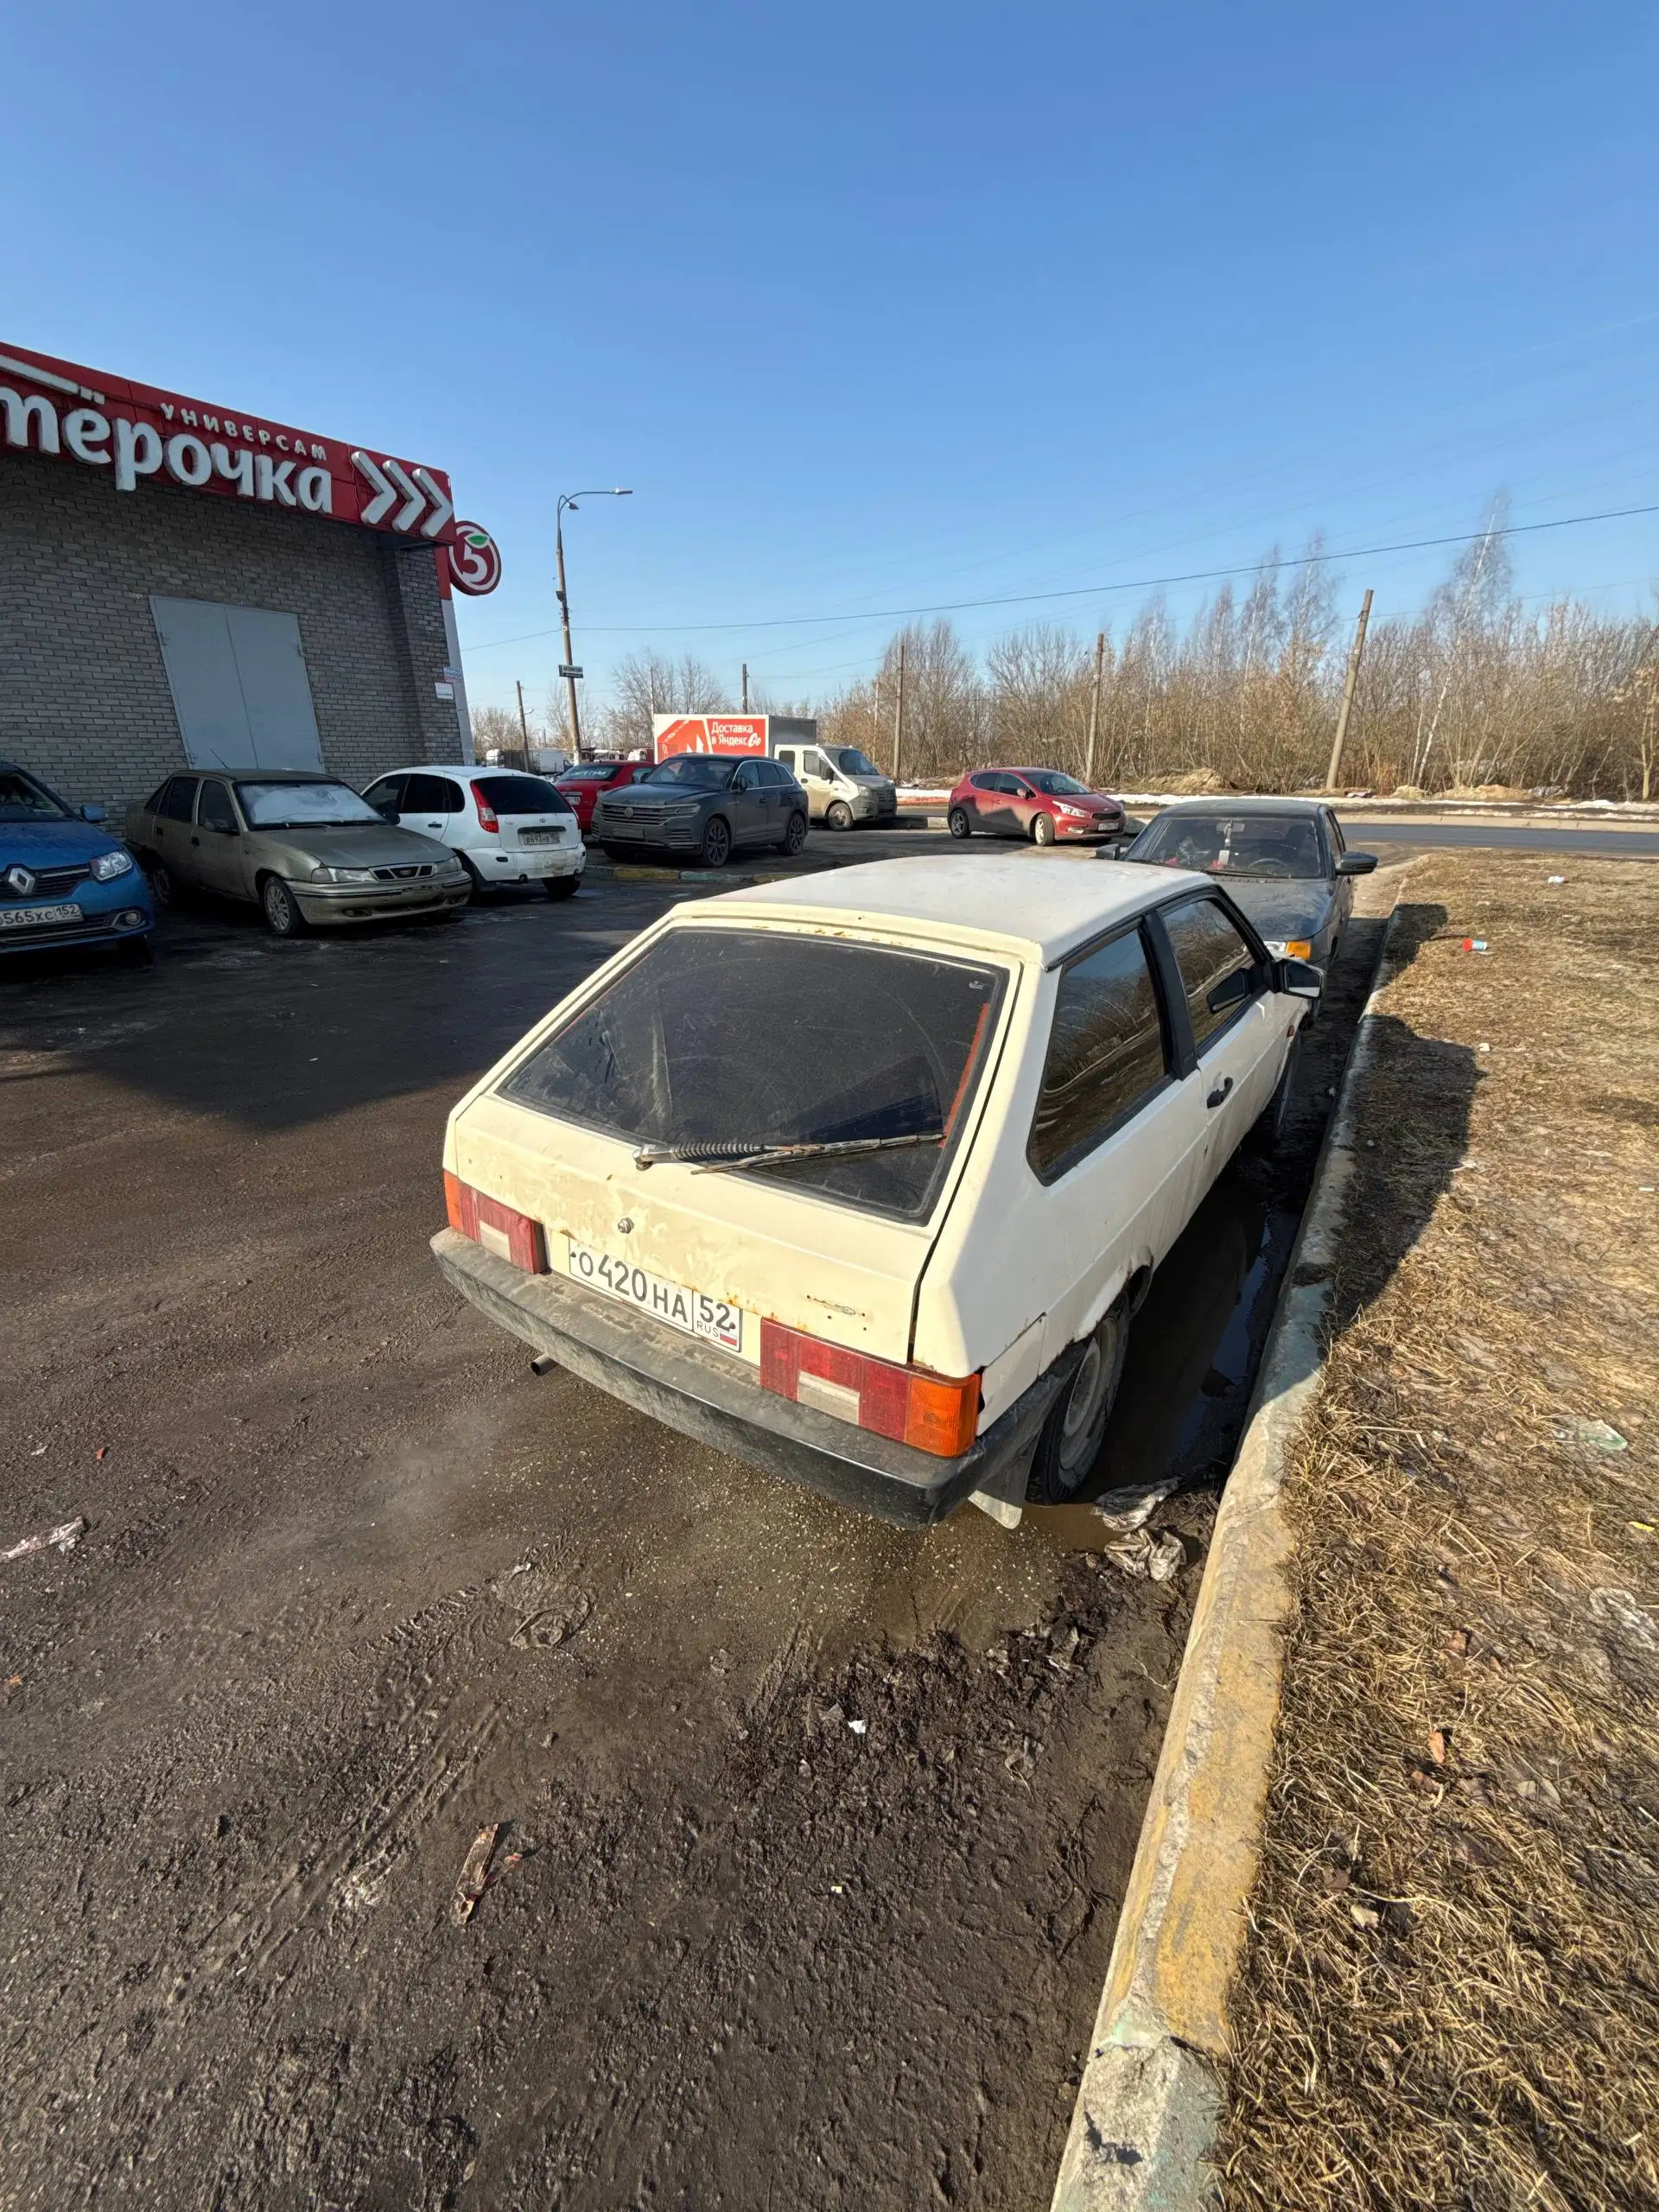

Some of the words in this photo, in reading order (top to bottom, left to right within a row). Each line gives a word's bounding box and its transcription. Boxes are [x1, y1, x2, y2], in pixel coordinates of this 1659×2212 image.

[161, 402, 327, 461] УНИВЕРСАМ
[461, 543, 488, 582] 5
[711, 721, 753, 734] Доставка
[711, 736, 717, 745] в
[719, 734, 747, 747] Яндекс
[56, 905, 77, 916] 152
[579, 1251, 688, 1324] О420НА
[700, 1294, 733, 1332] 52
[696, 1319, 719, 1338] RUS
